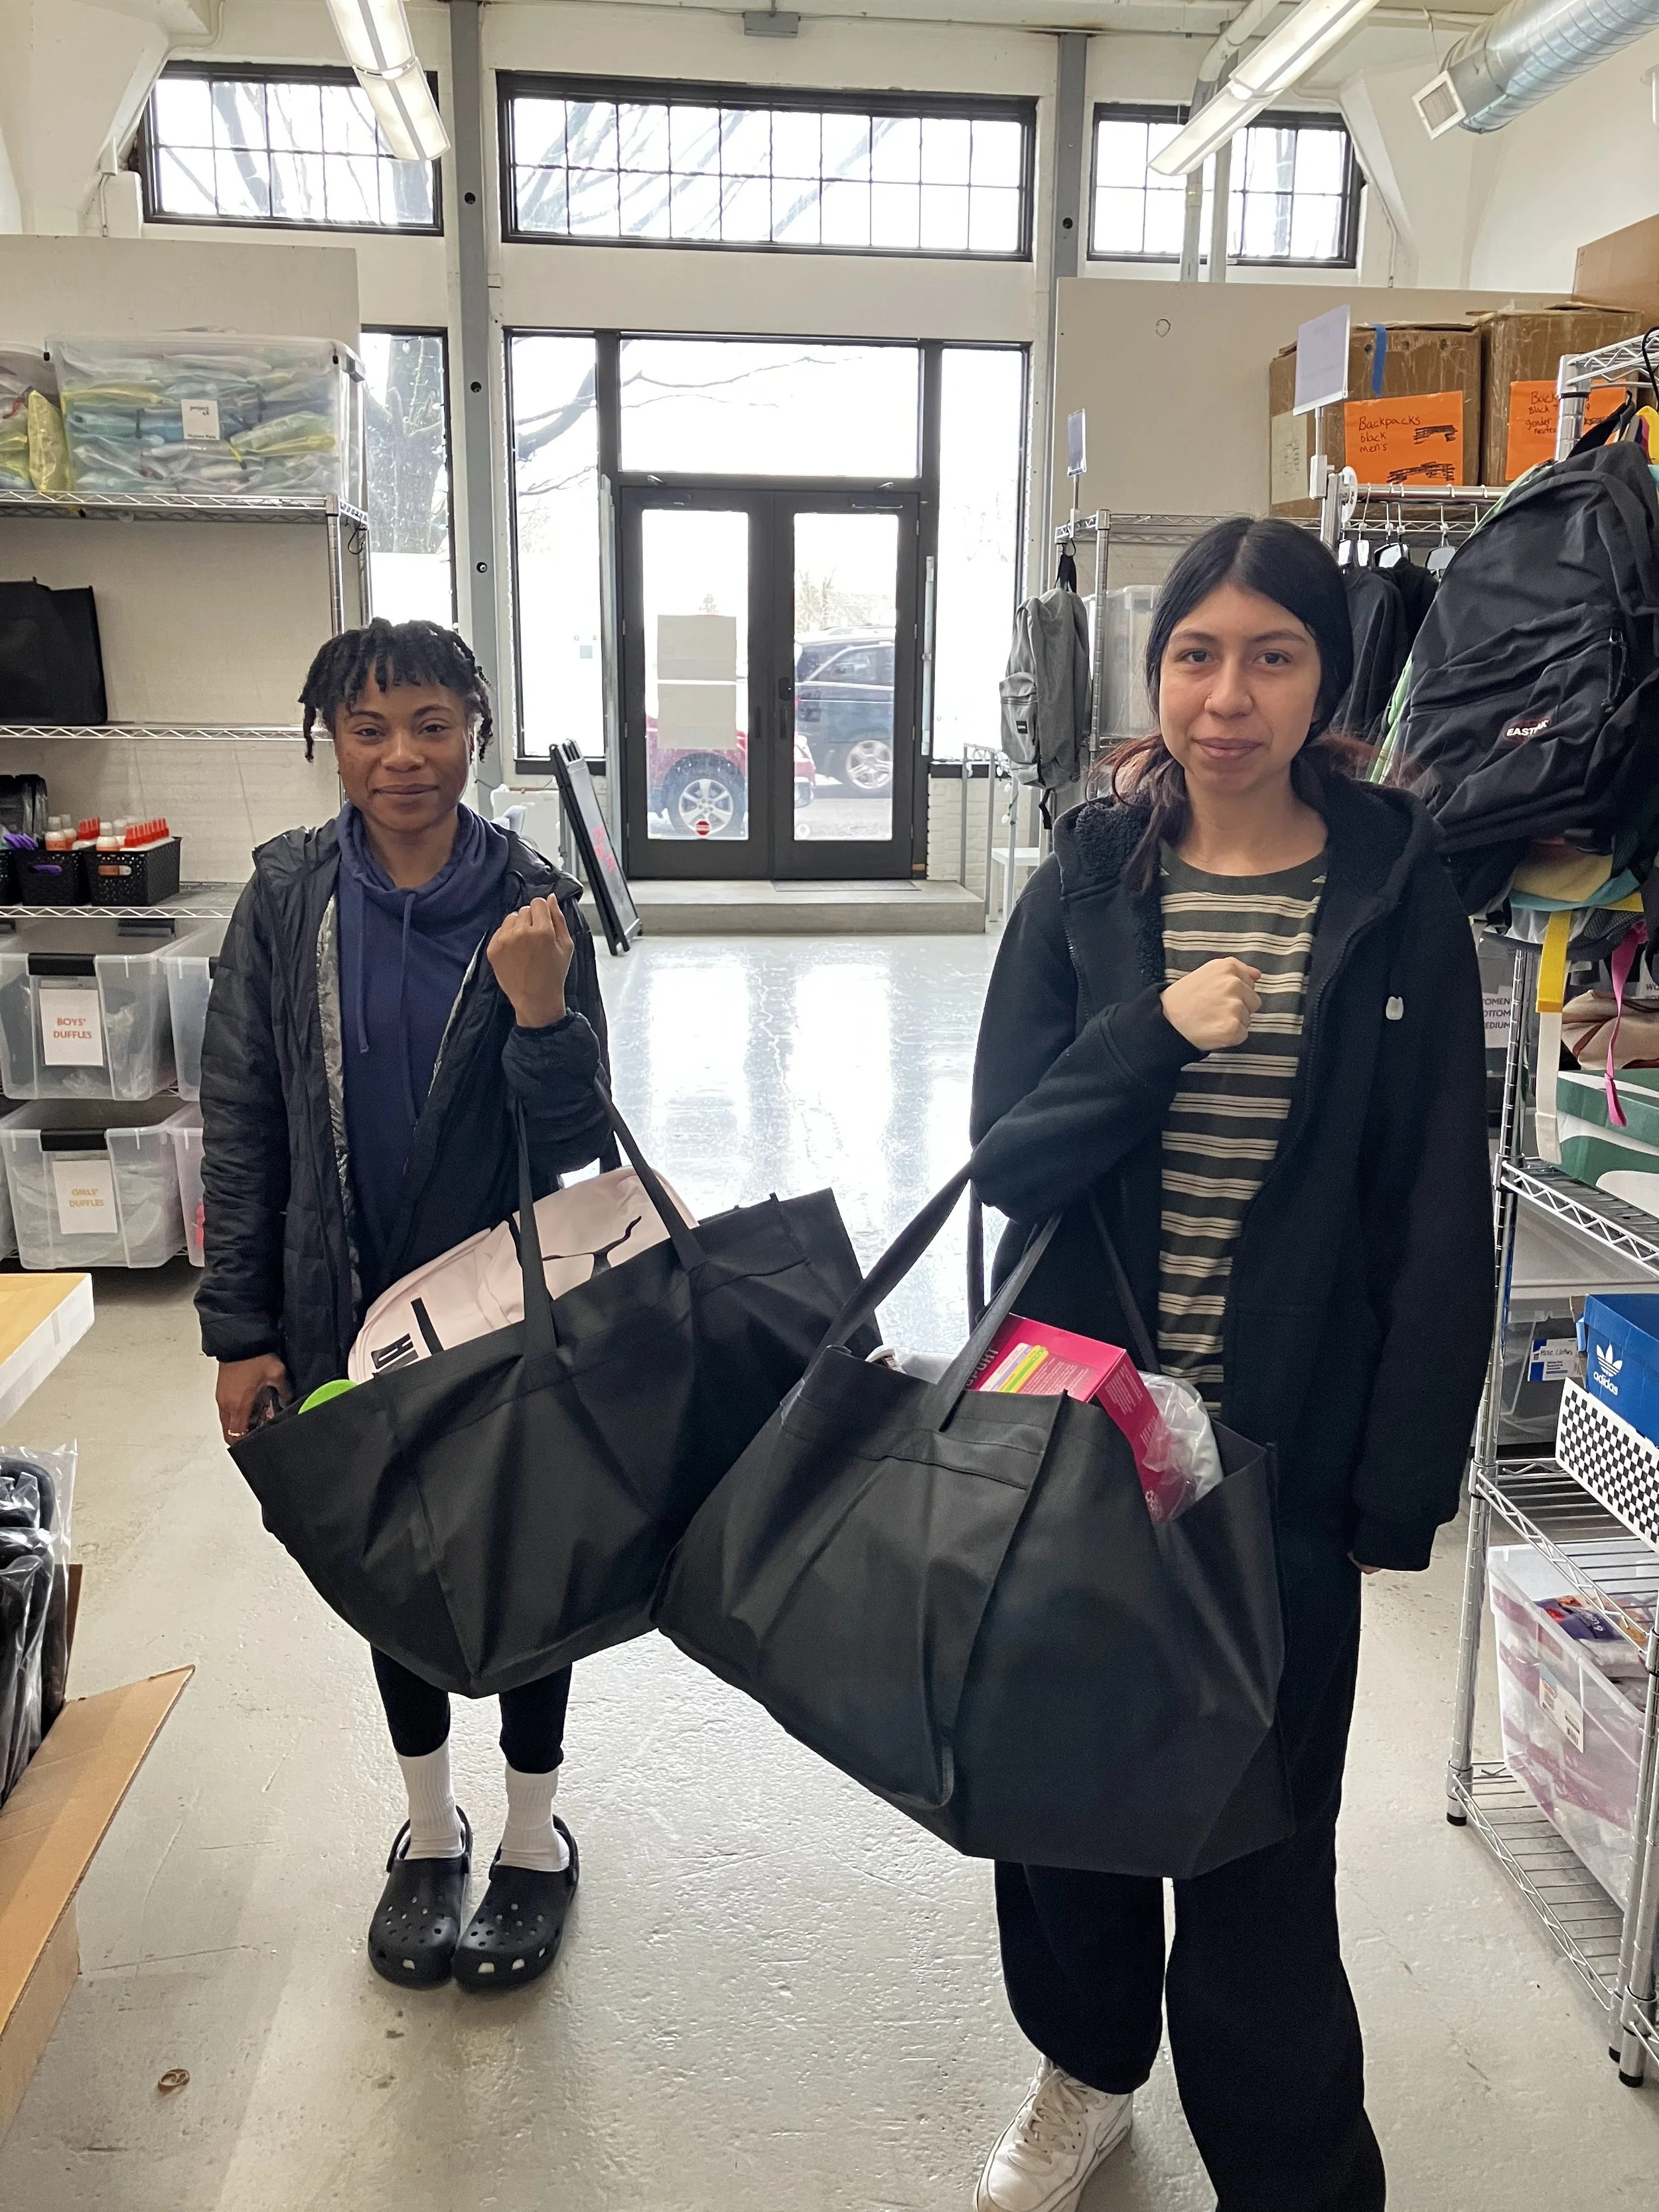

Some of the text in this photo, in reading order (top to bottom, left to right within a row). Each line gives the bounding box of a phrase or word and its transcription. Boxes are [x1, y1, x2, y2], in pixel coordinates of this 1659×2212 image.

[1358, 415, 1421, 431] Backpacks
[1361, 432, 1386, 443] black
[1506, 720, 1549, 736] EASTAK
[1594, 1371, 1618, 1396] adidas
